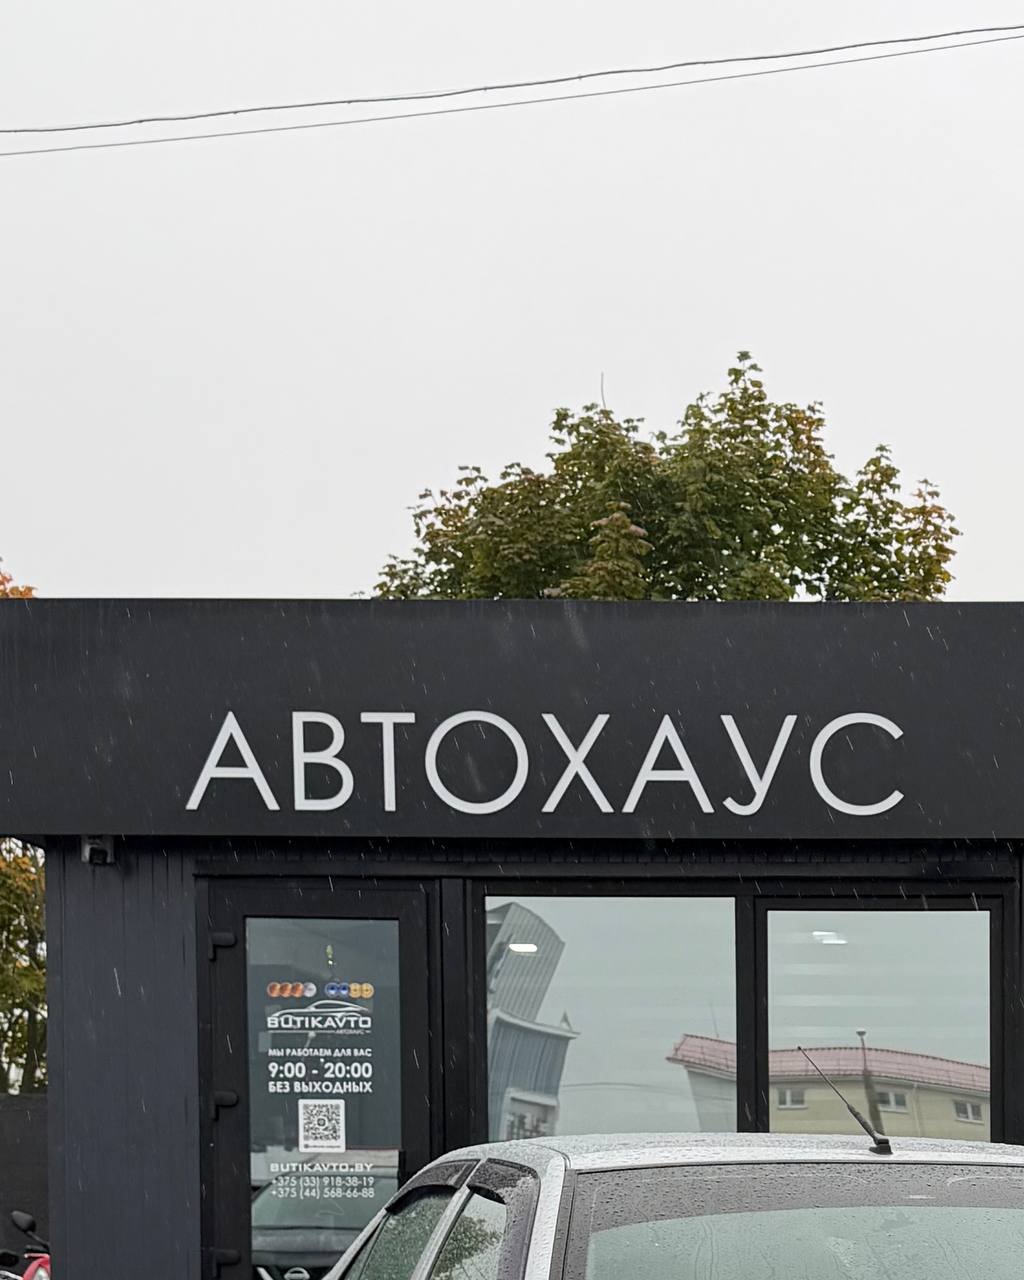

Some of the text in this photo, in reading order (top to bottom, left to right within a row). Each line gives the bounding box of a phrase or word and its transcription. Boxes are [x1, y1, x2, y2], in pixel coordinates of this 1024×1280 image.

[185, 710, 905, 816] АВТОХАУС
[267, 1016, 372, 1028] BUTIKAVTO
[268, 1048, 372, 1058] МЫ РАБОТАЕМ ДЛЯ ВАС
[268, 1062, 306, 1078] 9:00
[324, 1062, 373, 1078] 20:00
[268, 1081, 373, 1094] БЕЗ ВЫХОДНЫХ
[270, 1162, 374, 1172] BUTIKAVTO.BY
[272, 1175, 375, 1189] +375 (33) 918-38-19
[272, 1187, 375, 1200] +375 (44) 568-66-88
